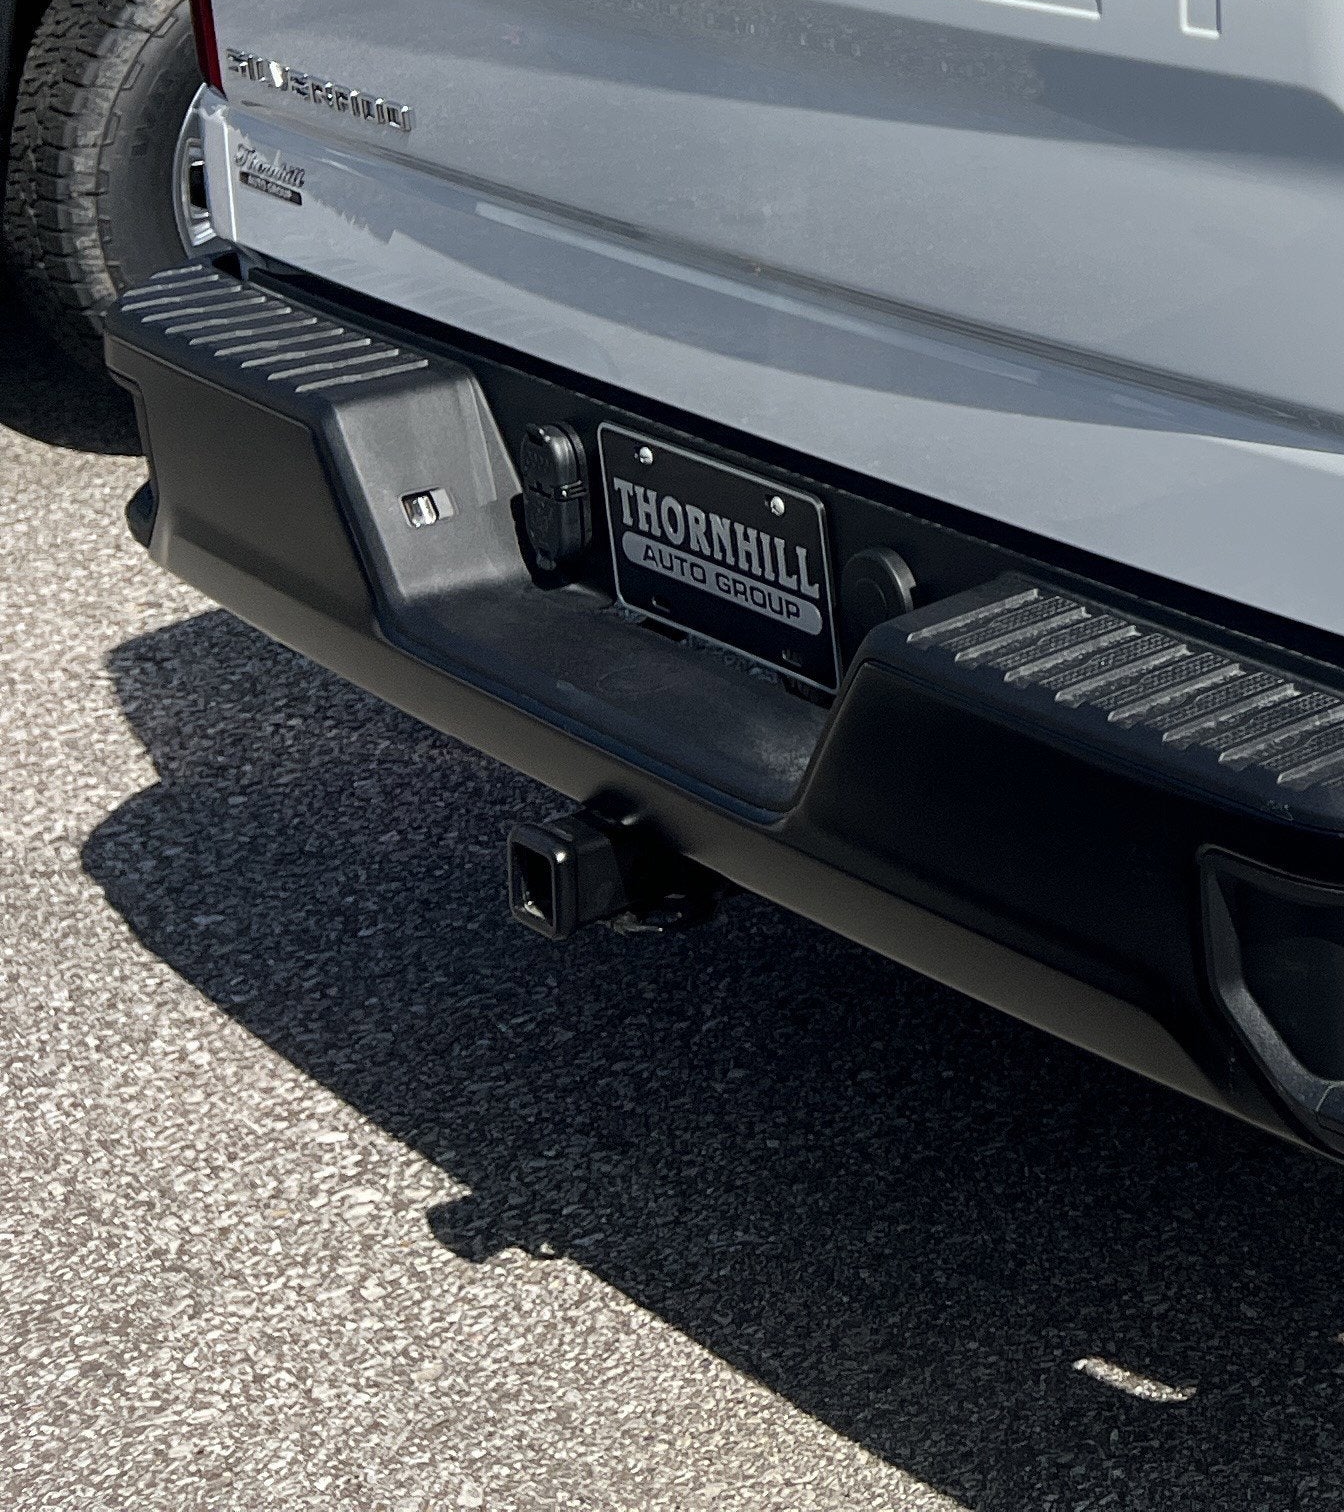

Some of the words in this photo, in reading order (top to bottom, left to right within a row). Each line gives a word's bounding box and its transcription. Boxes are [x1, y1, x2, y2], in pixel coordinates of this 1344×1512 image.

[613, 476, 820, 599] THORNHILL
[642, 544, 707, 585] AUTO
[715, 571, 801, 620] GROUP
